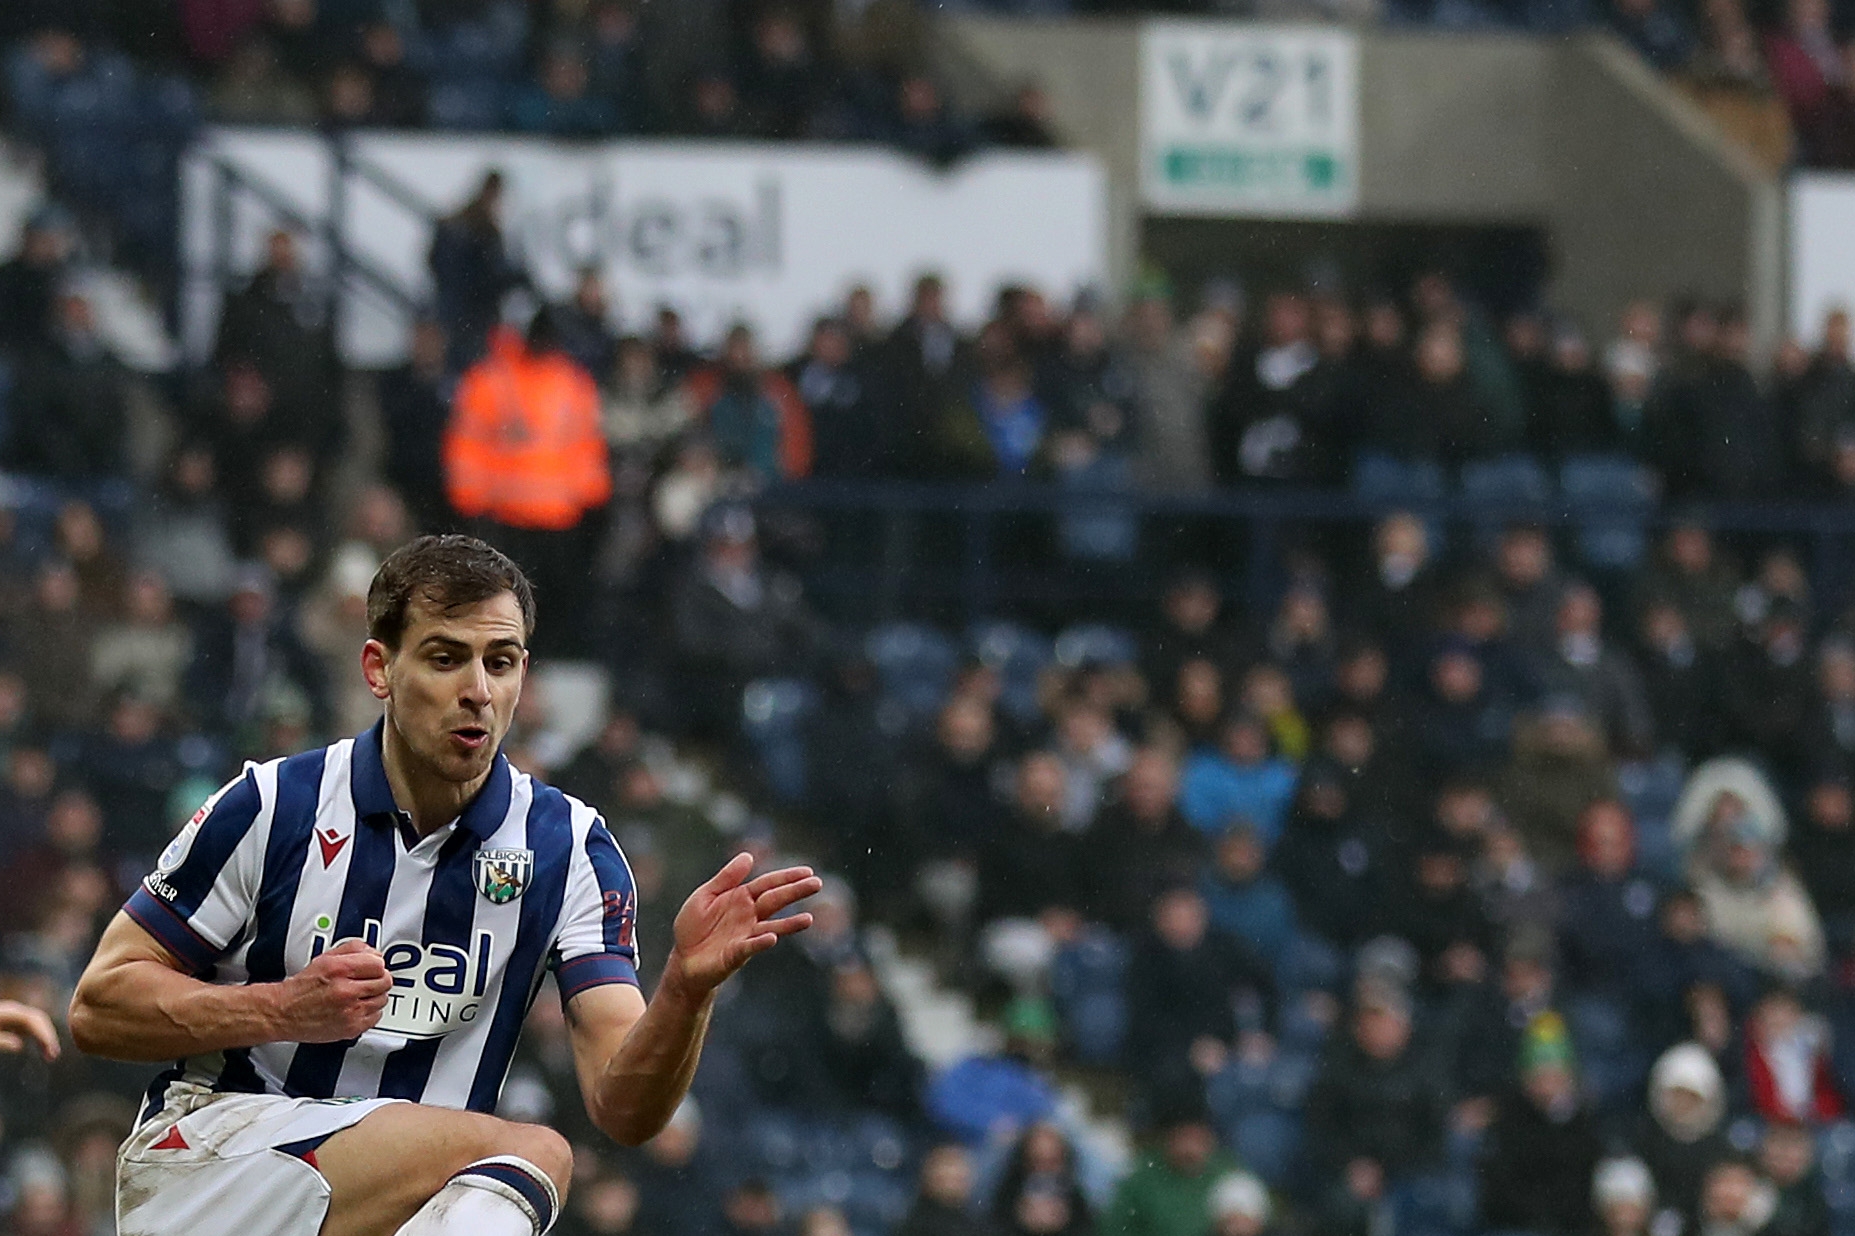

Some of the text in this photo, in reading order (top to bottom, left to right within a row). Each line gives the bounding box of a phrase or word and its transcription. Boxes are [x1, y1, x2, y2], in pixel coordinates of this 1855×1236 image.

[1164, 49, 1334, 131] V21
[477, 851, 528, 861] ALBION
[310, 916, 493, 997] ieal
[389, 994, 478, 1023] TING
